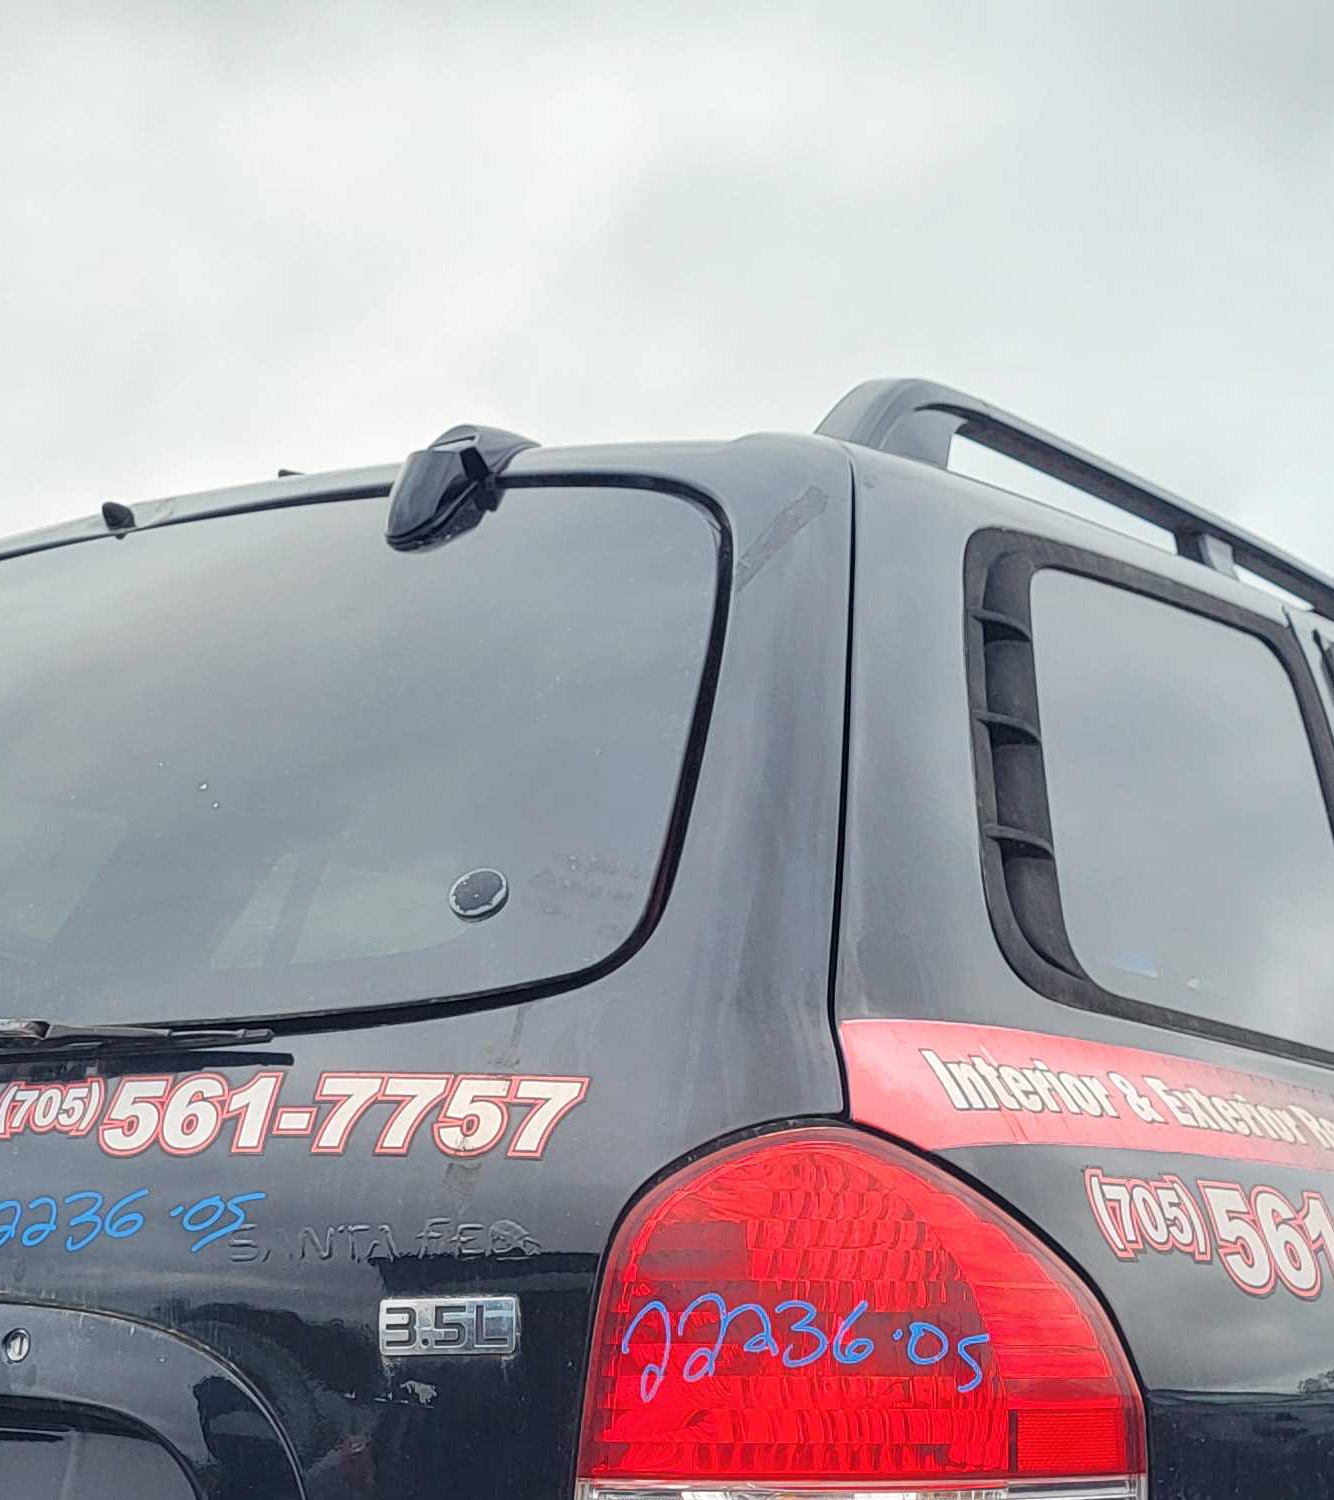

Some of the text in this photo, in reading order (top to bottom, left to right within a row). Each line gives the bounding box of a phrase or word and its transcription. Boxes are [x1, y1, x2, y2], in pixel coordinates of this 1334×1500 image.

[98, 1071, 590, 1159] 561-7757
[919, 1048, 1119, 1115] Interior
[1108, 1071, 1168, 1123] &
[1146, 1077, 1315, 1147] Exterior
[1083, 1168, 1211, 1262] (705)
[385, 1303, 517, 1352] 3.5L
